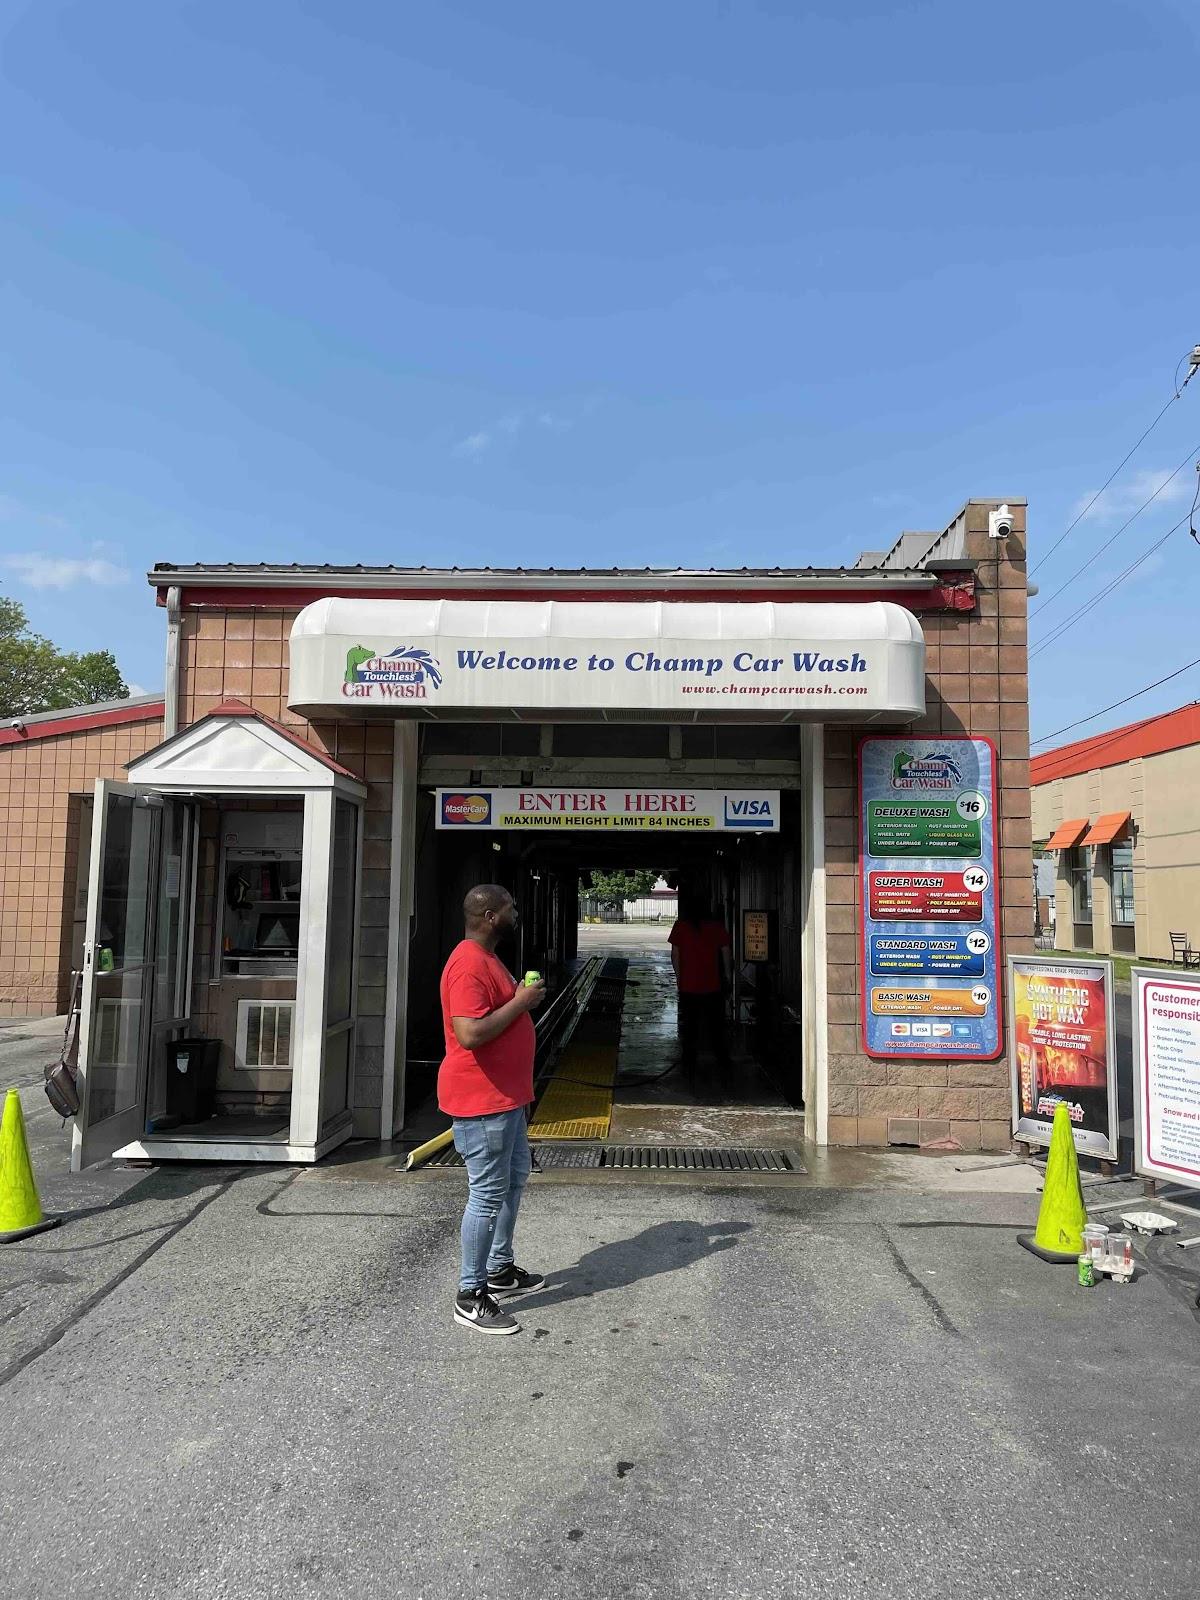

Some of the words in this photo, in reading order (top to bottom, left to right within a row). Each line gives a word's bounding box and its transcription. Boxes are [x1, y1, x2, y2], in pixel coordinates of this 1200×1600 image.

[367, 657, 422, 674] Champ
[457, 650, 578, 671] Welcome
[587, 653, 615, 671] to
[625, 652, 724, 676] Champ
[733, 652, 784, 672] Car
[793, 652, 867, 673] Wash
[363, 671, 415, 682] Touchless
[342, 682, 374, 698] Car
[377, 682, 427, 698] Wash
[682, 683, 868, 696] www.champcarwash.com
[908, 760, 949, 771] Champ
[906, 770, 943, 778] Touchless
[892, 778, 913, 789] Car
[915, 778, 952, 789] Wash
[518, 793, 607, 811] ENTER
[624, 794, 696, 812] HERE
[730, 800, 771, 815] VISA
[960, 801, 980, 813] $16
[445, 804, 489, 814] MasterCard
[874, 808, 917, 817] DELUXE
[920, 808, 950, 817] WASH
[504, 816, 562, 825] MAXIMUM
[565, 817, 610, 826] HEIGHT
[613, 817, 645, 826] LIMIT
[649, 817, 663, 826] 84
[666, 817, 710, 827] INCHES
[875, 877, 911, 887] SUPER
[913, 878, 943, 887] WASH
[966, 875, 984, 885] $14
[876, 940, 927, 949] STANDARD
[929, 941, 956, 950] WASH
[969, 938, 985, 948] $12
[973, 992, 987, 1000] $10
[1026, 984, 1090, 1007] SYNTHETIC
[1151, 991, 1200, 1007] Customer
[1032, 1002, 1053, 1021] HOT
[1052, 1031, 1066, 1040] LONG
[1066, 1033, 1092, 1042] LASTING
[1052, 1039, 1086, 1050] PROTECTION
[1163, 1107, 1182, 1117] Snow
[1183, 1112, 1196, 1120] and
